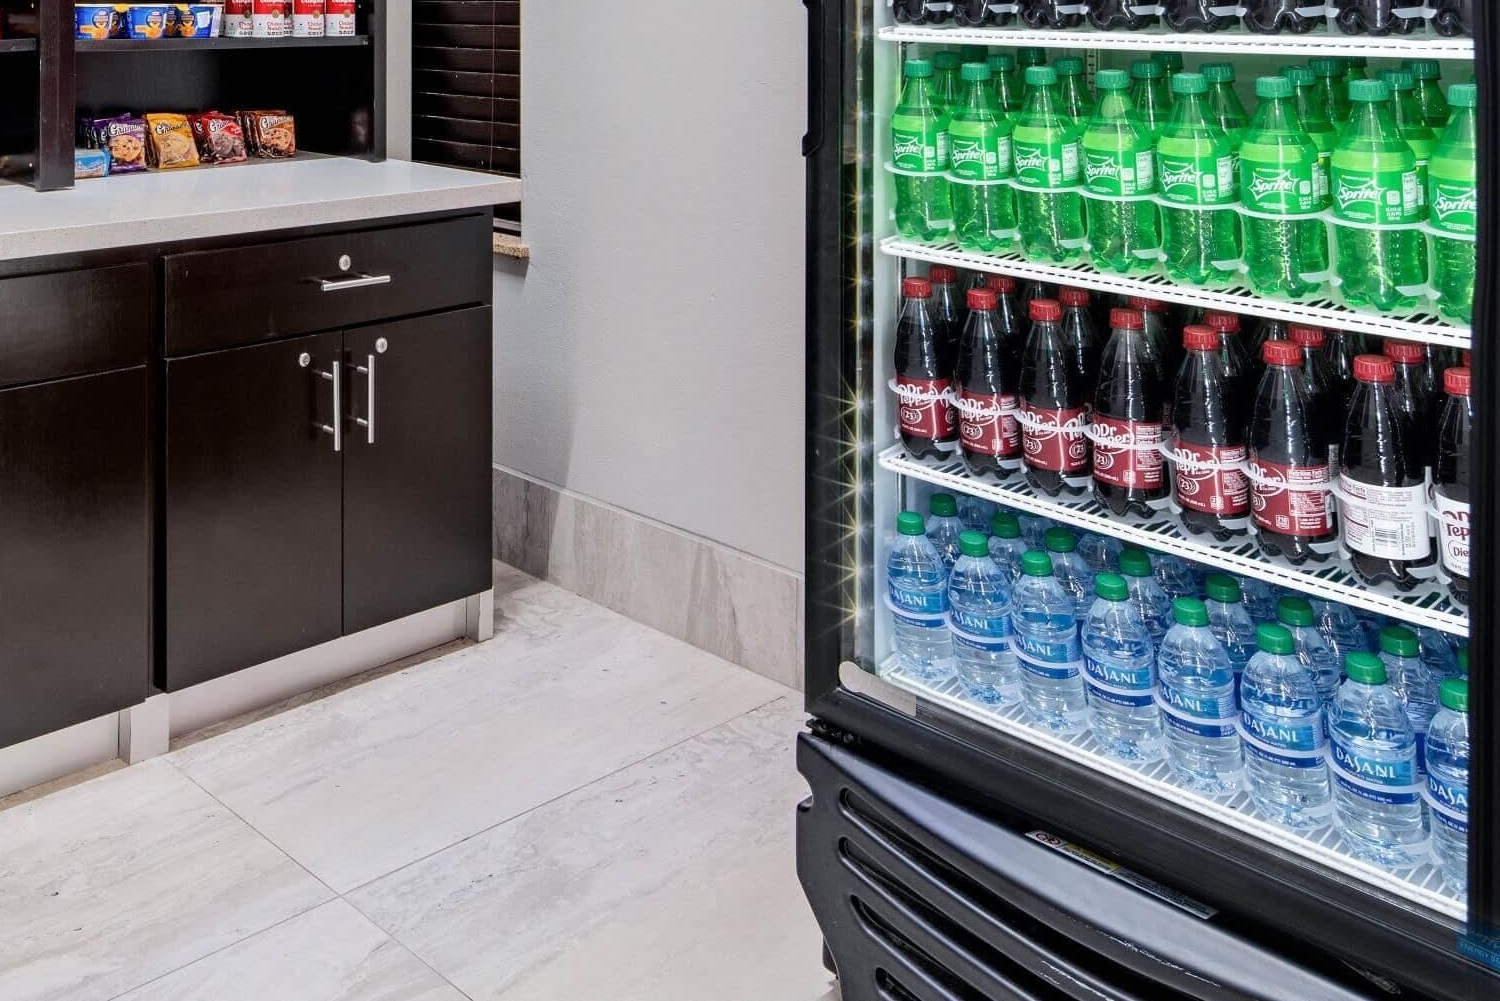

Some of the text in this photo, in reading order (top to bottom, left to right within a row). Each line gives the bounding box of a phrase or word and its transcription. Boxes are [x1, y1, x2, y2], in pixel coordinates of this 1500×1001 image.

[1016, 156, 1044, 168] Sprite
[1087, 164, 1117, 177] Sprite
[1163, 172, 1196, 184] Sprite
[1254, 178, 1293, 194] Sprite
[1339, 187, 1379, 201] Sprite
[905, 411, 918, 420] 23
[966, 427, 977, 435] 23
[1087, 659, 1138, 684] DASANI
[1244, 712, 1300, 743] DASANI
[1336, 746, 1397, 779] DASANI
